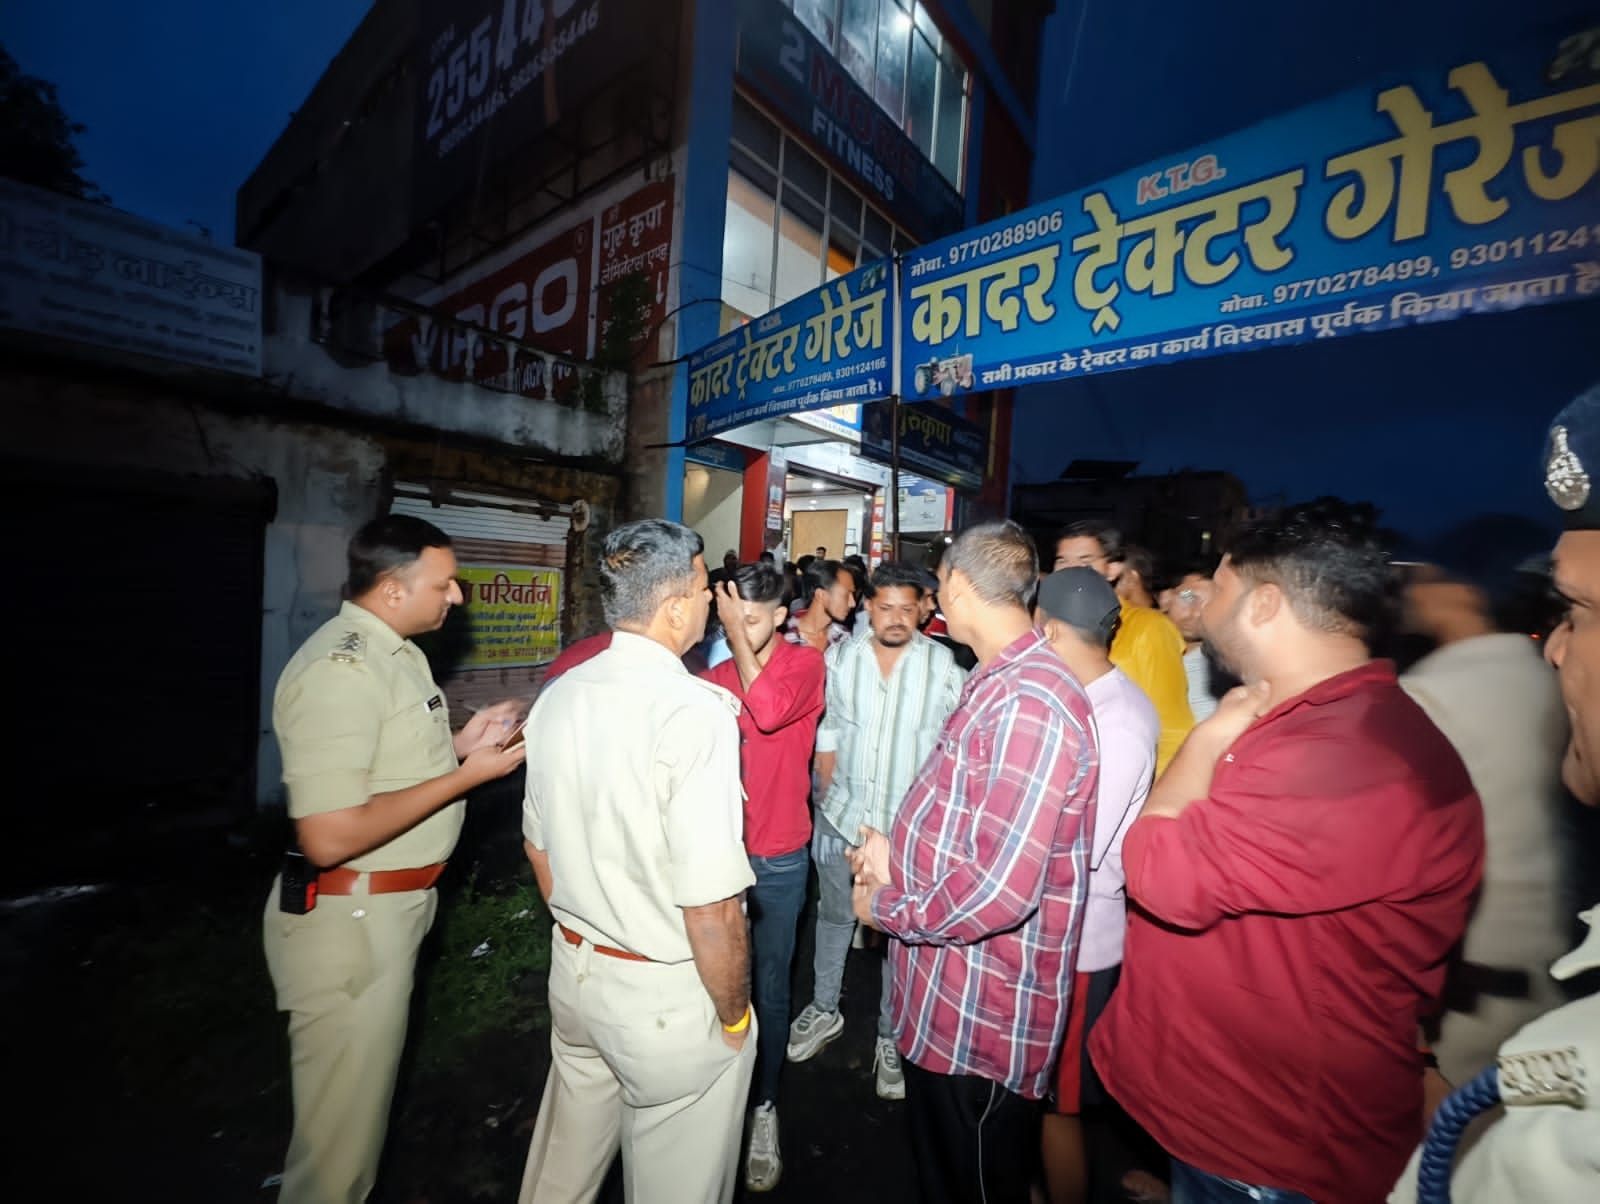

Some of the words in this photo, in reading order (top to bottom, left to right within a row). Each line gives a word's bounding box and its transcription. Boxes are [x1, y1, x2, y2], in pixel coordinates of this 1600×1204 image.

[426, 0, 577, 141] 25544
[779, 17, 806, 85] 2
[812, 107, 895, 201] FITNESS
[1136, 154, 1227, 206] K.T.G.
[629, 200, 667, 248] कृपा
[911, 244, 1060, 346] कादर
[1073, 168, 1305, 334] ट्रेक्टर
[949, 211, 1063, 266] 9770288906
[1273, 255, 1441, 304] 9770278499,
[690, 353, 735, 408] कादर
[736, 326, 801, 401] ट्रेक्टर
[805, 279, 887, 364] गेरेज
[982, 363, 1012, 385] सभी
[1014, 360, 1057, 380] प्रकार
[1059, 353, 1078, 371] के
[1130, 342, 1157, 360] का
[1162, 325, 1209, 354] कार्य
[1214, 317, 1305, 350] विश्वास
[1311, 301, 1385, 338] पूर्वक
[1390, 287, 1476, 324] किया
[1481, 272, 1568, 304] जाता
[479, 573, 552, 605] परिवर्तन
